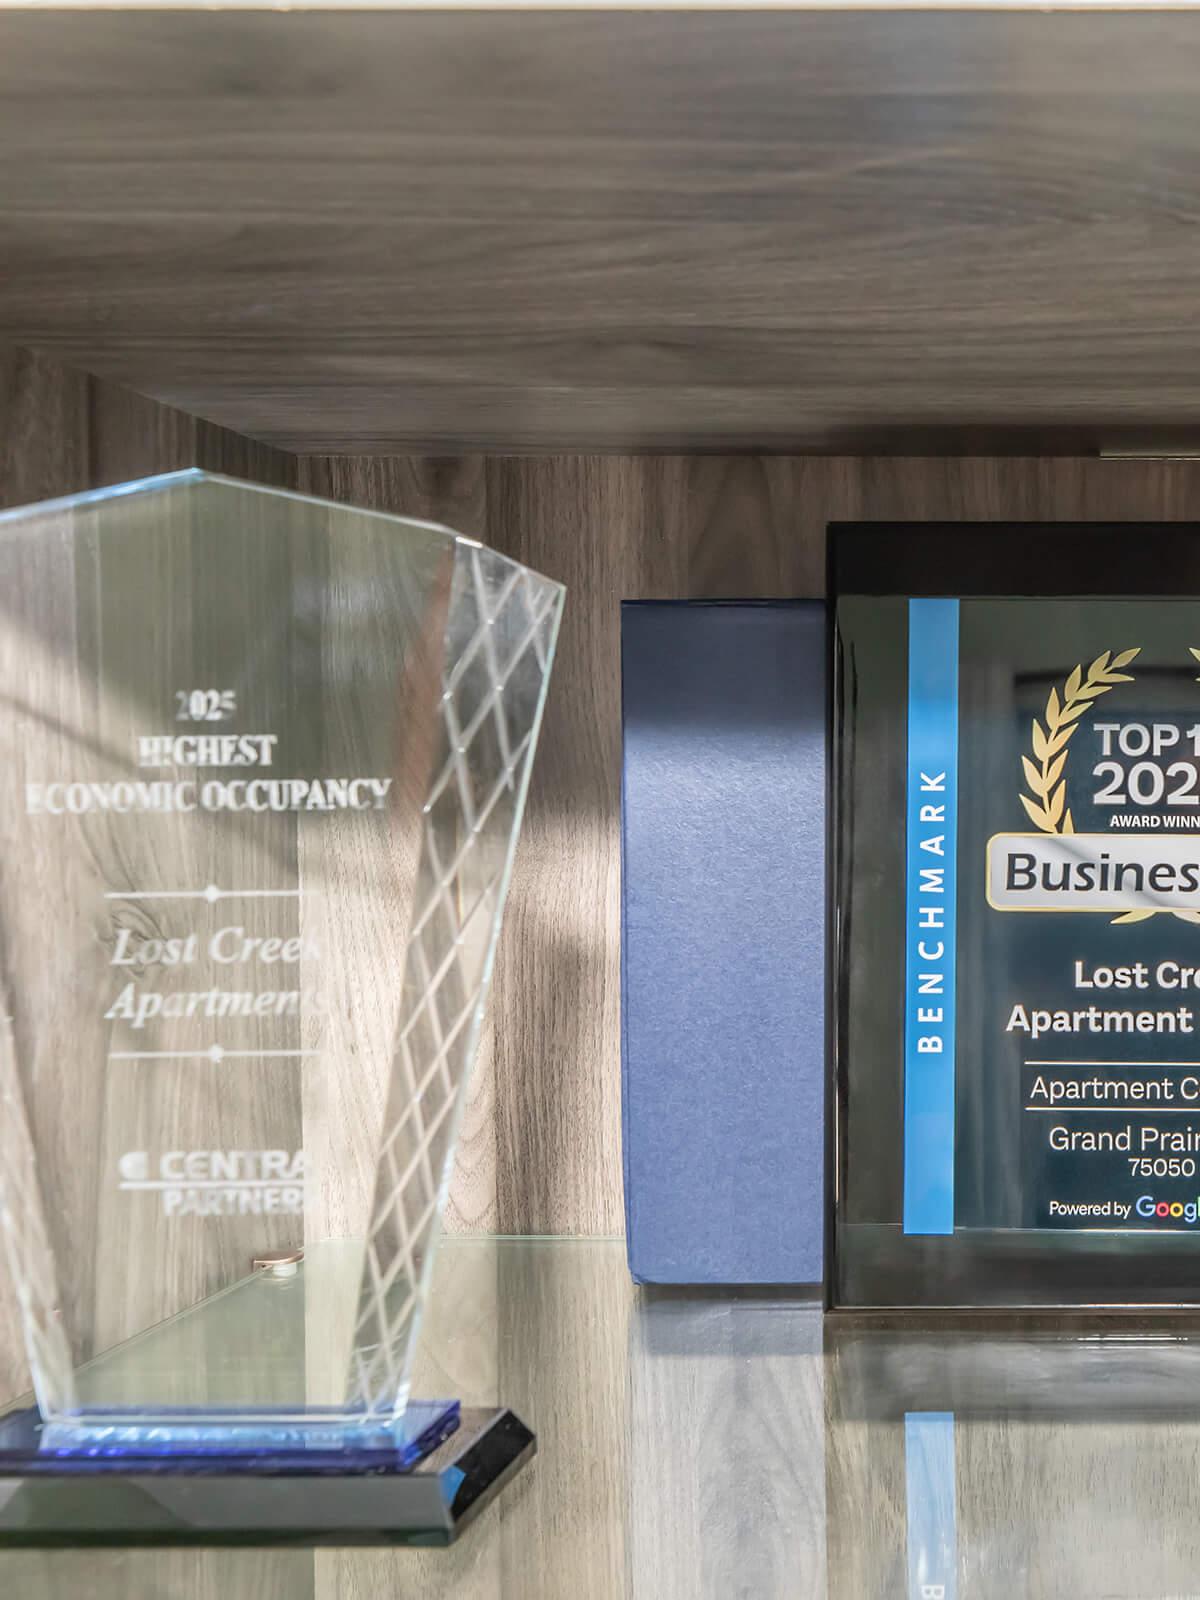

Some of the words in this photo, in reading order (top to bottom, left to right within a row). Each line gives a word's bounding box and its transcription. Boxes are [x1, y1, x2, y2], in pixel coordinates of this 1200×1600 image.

[137, 733, 279, 768] HIGHEST
[1093, 723, 1180, 757] TOP
[24, 779, 197, 816] ECONOMIC
[199, 776, 393, 813] OCCUPANCY
[1109, 814, 1161, 829] AWARD
[916, 771, 946, 1054] BENCHMARK
[110, 927, 198, 967] Lost
[1074, 960, 1149, 990] Lost
[1005, 1004, 1194, 1039] Apartment
[1030, 1075, 1175, 1105] Apartment
[1049, 1125, 1131, 1151] Grand
[1127, 1157, 1196, 1178] 75050
[162, 1187, 308, 1218] PARTNER
[1049, 1200, 1111, 1216] Powered
[1113, 1201, 1131, 1219] by
